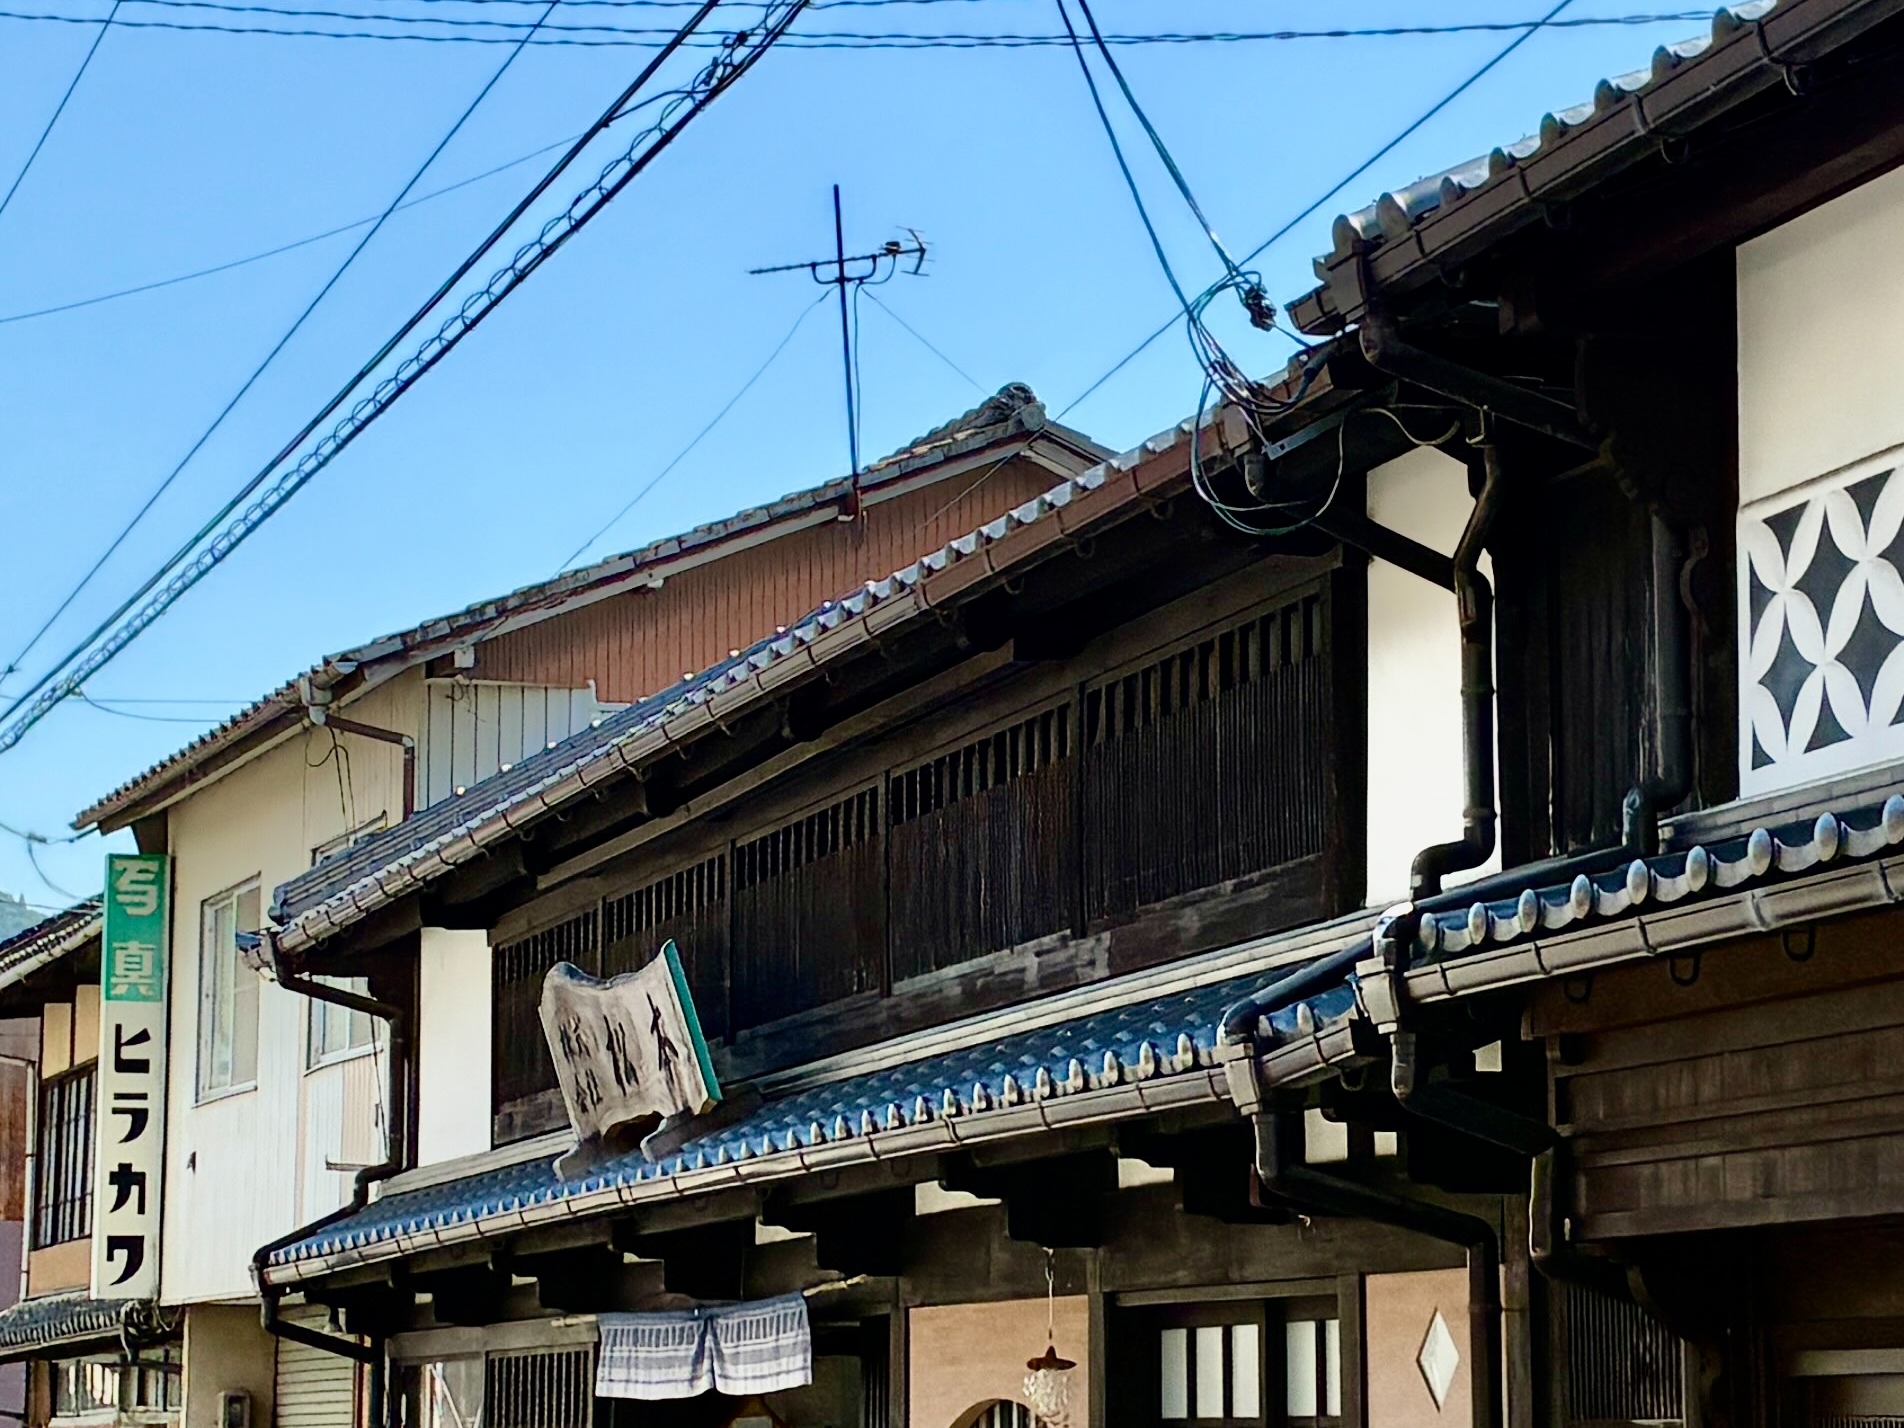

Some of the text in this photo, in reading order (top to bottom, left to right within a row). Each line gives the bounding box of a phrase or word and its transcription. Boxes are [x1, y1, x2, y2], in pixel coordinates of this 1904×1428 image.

[106, 859, 159, 1287] 写真 ヒラカワ
